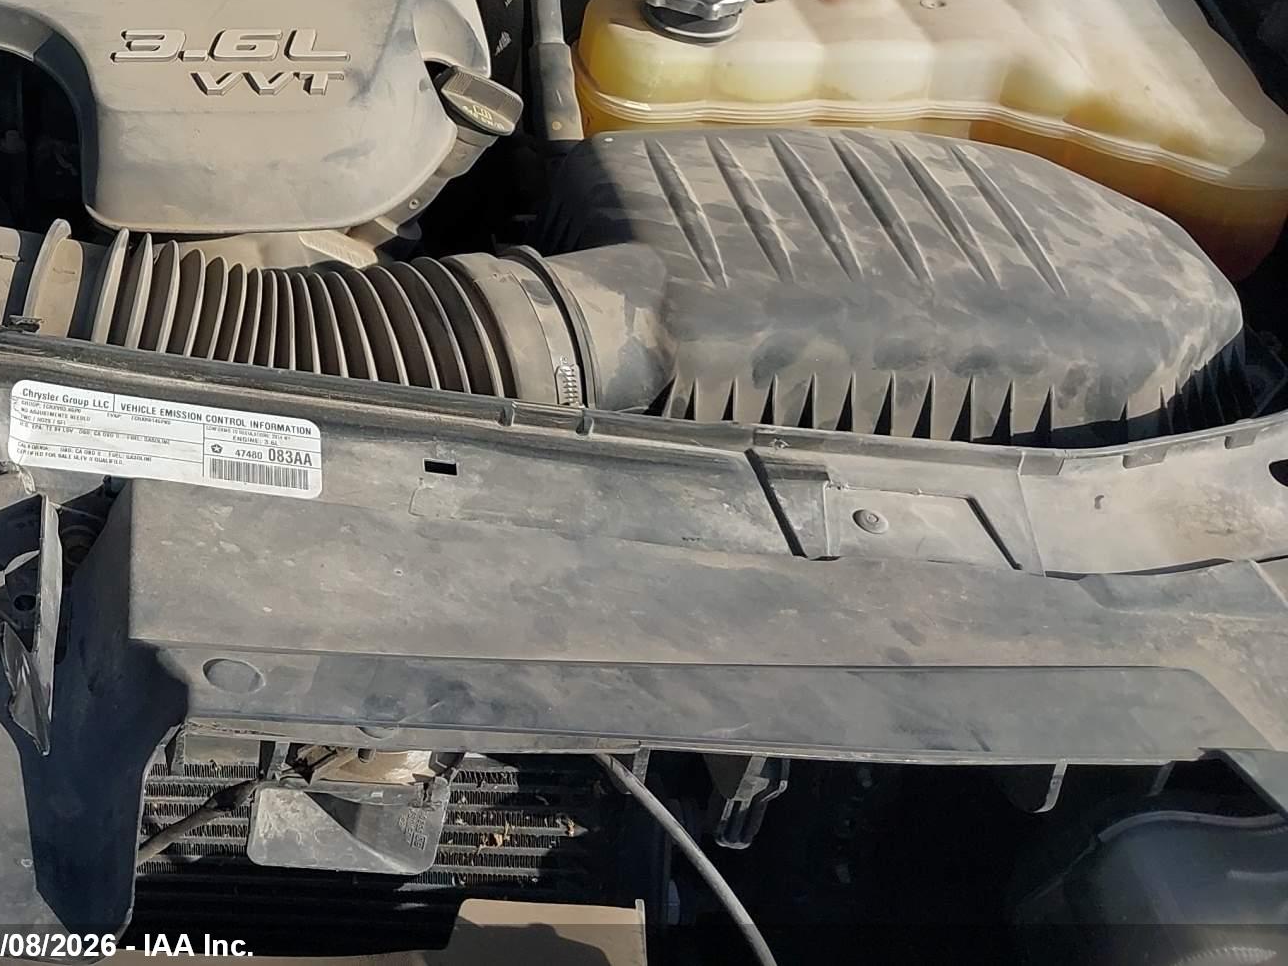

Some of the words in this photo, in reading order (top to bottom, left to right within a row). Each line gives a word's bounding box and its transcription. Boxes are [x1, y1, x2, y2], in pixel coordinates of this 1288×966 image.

[110, 28, 351, 62] 3.6L
[189, 71, 345, 96] VVT
[22, 388, 59, 402] Chrysler
[62, 395, 89, 408] Group
[93, 399, 109, 409] LLC
[120, 403, 156, 415] VEHICLE
[160, 408, 202, 421] EMISSION
[206, 415, 246, 427] CONTROL
[249, 420, 312, 435] INFORMATION
[235, 449, 263, 460] 47480
[268, 448, 313, 466] 083AA
